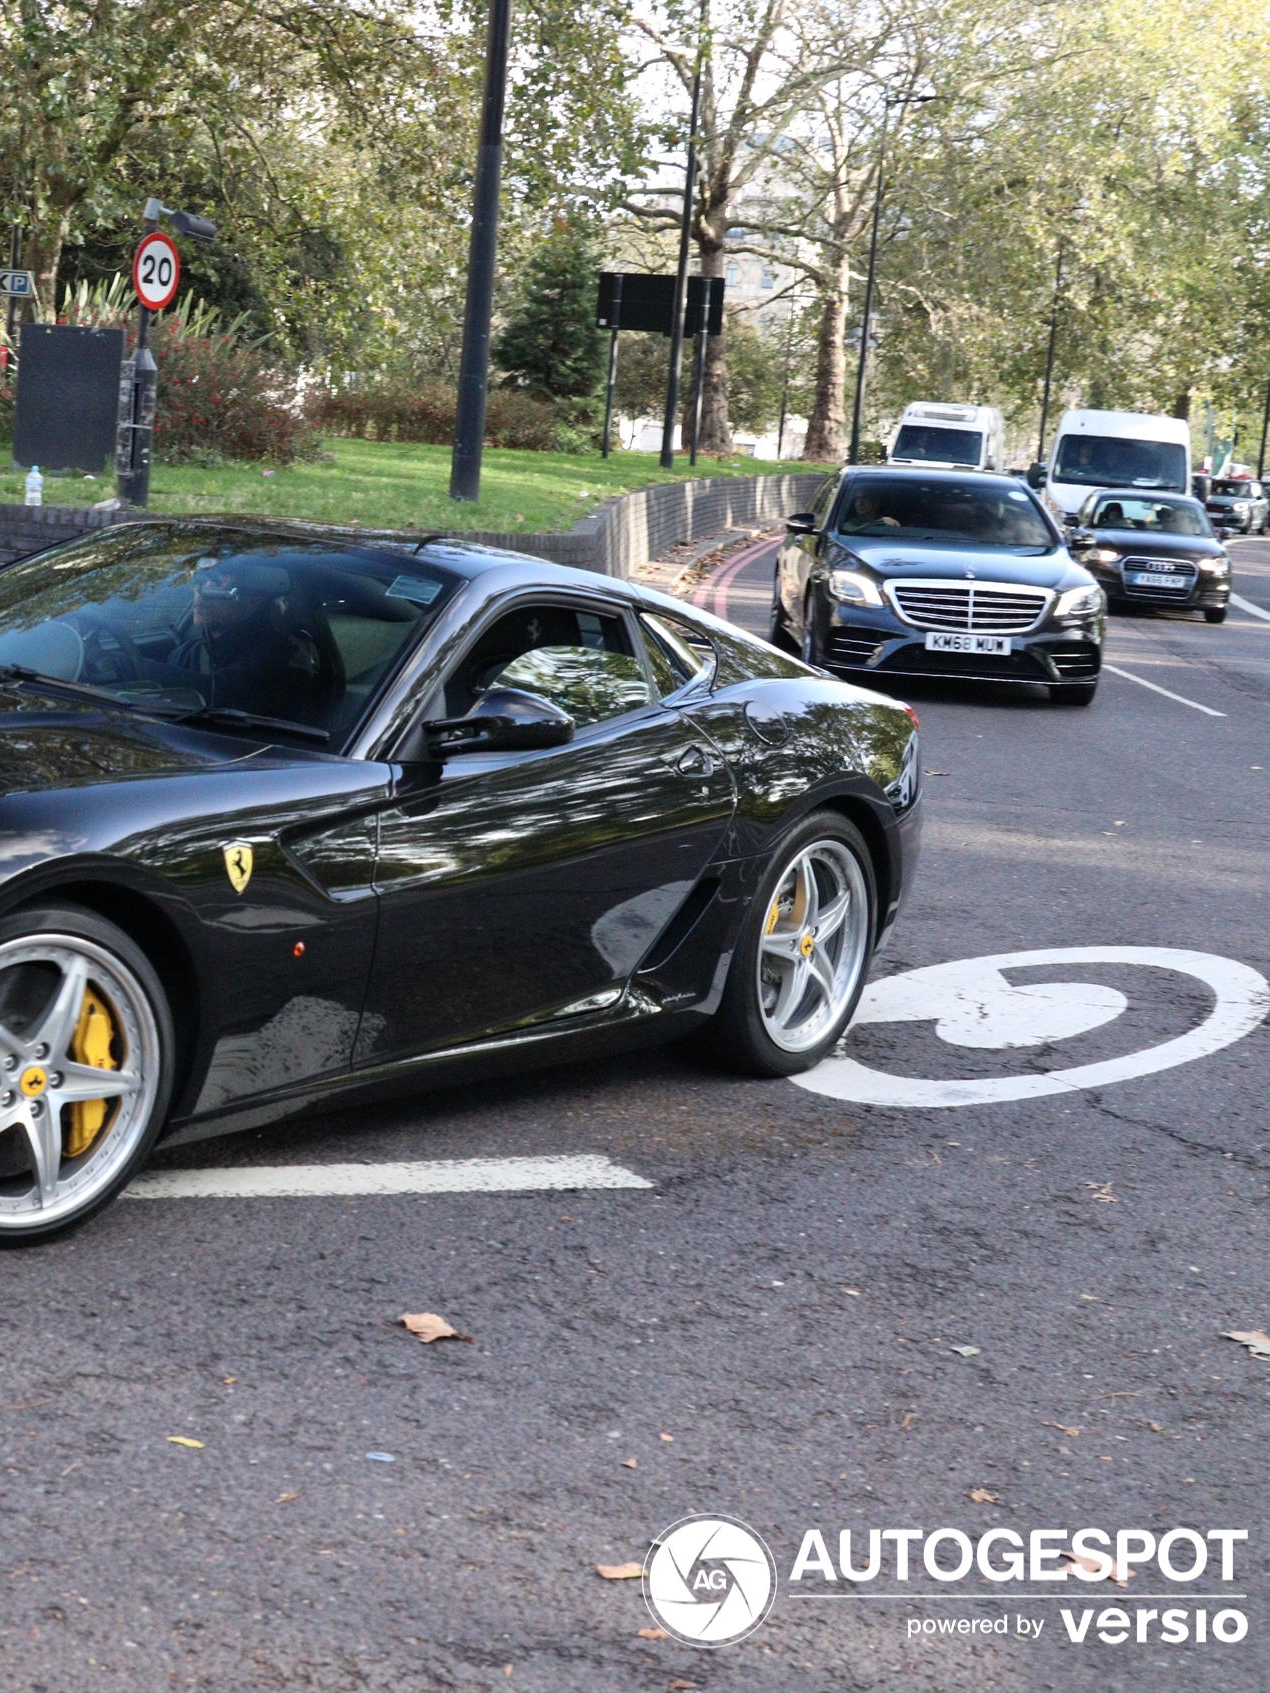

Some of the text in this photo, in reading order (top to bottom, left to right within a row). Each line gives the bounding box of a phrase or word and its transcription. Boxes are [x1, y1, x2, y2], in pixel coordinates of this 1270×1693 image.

[142, 254, 172, 287] 20
[13, 276, 26, 290] P
[933, 635, 972, 650] KM68
